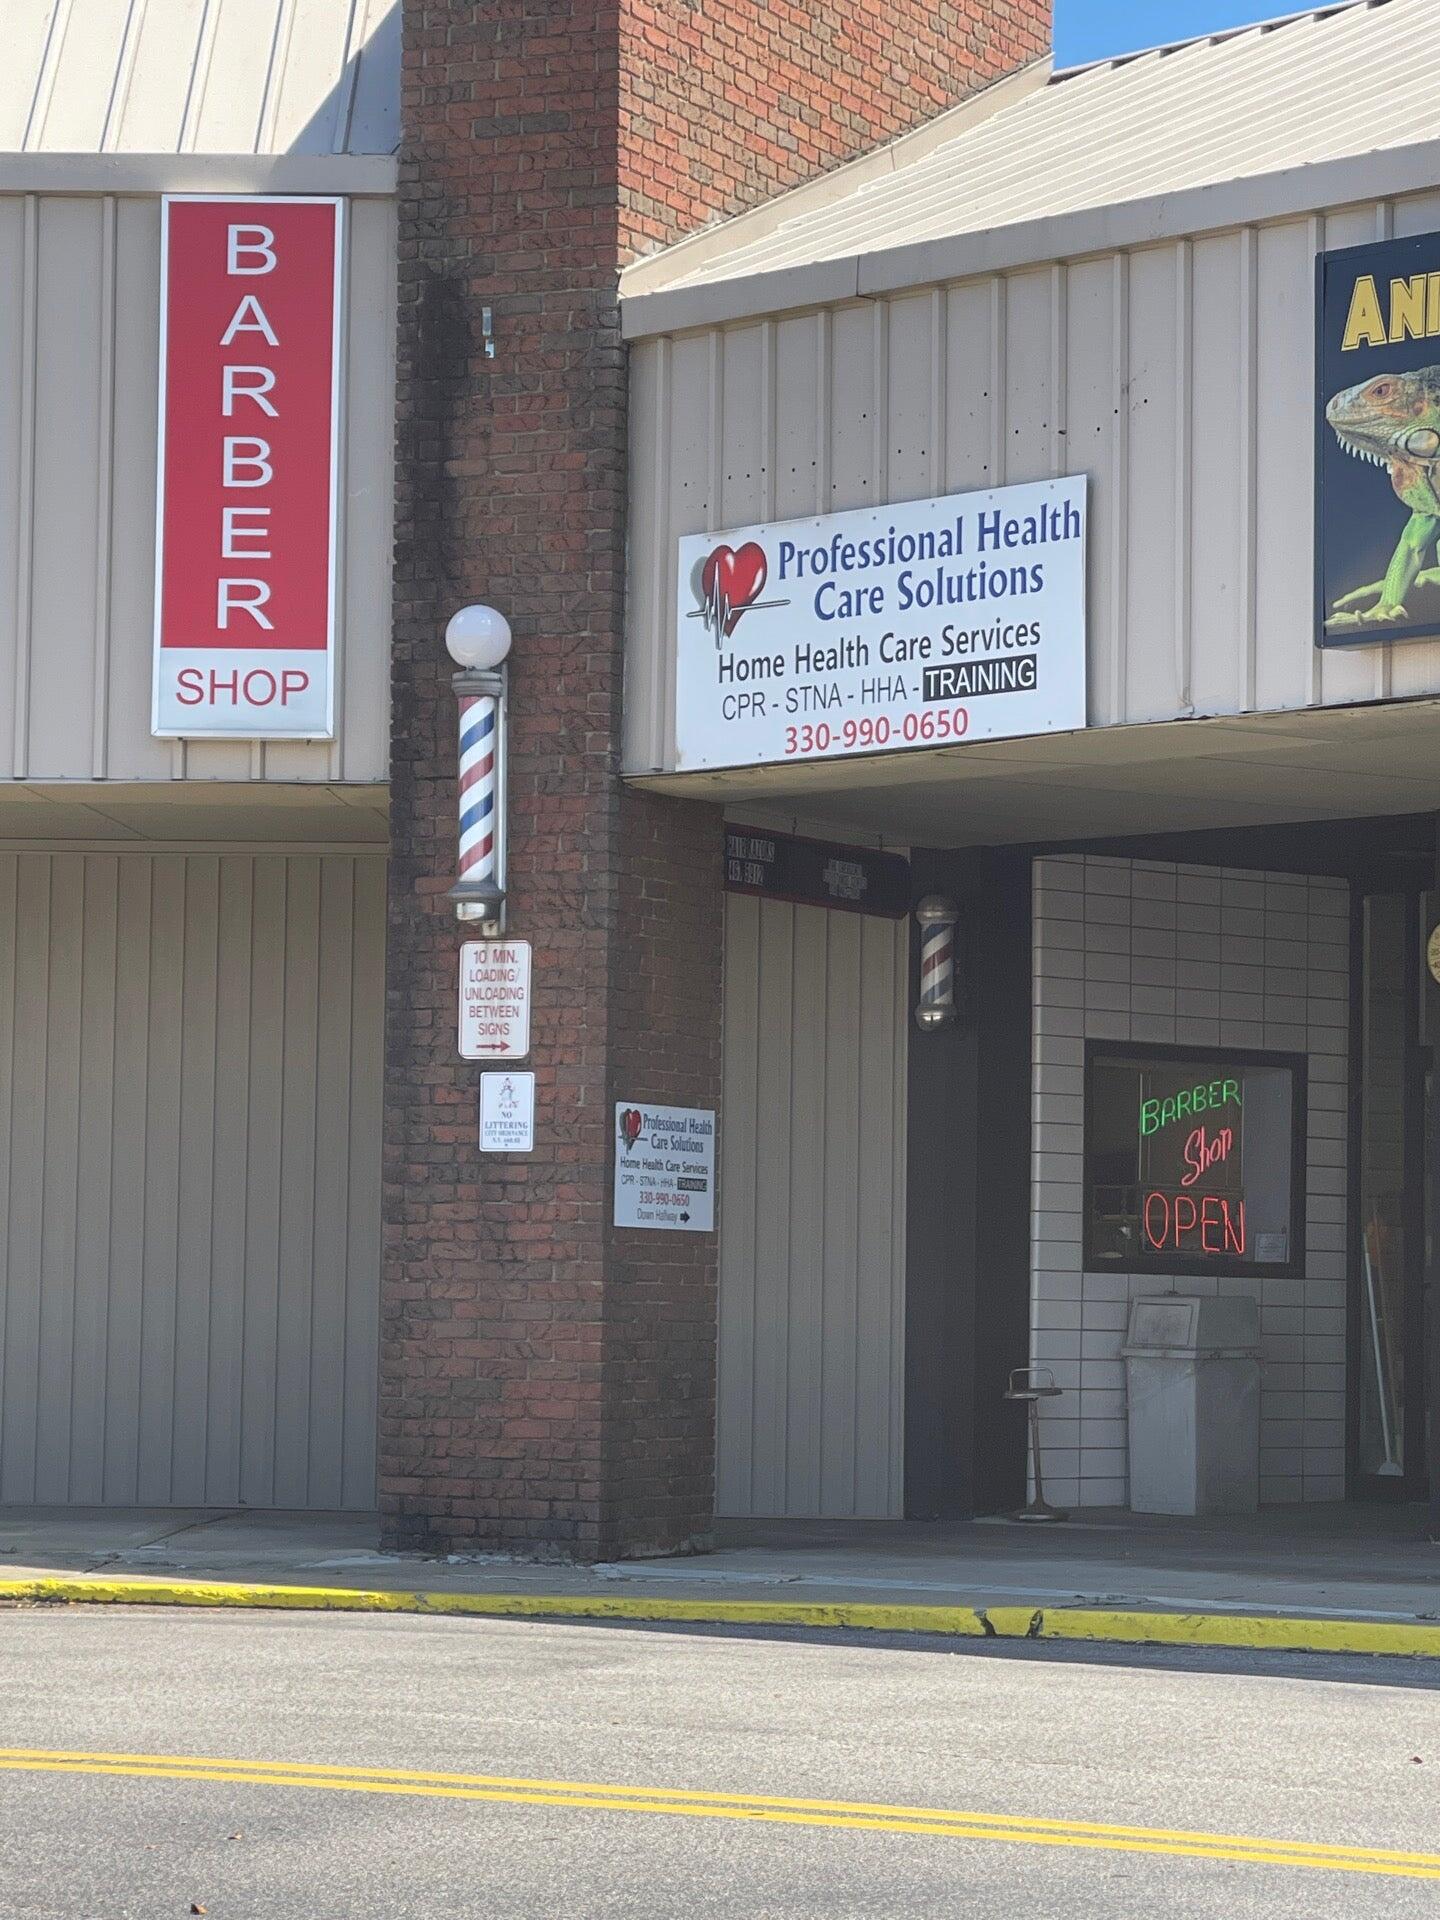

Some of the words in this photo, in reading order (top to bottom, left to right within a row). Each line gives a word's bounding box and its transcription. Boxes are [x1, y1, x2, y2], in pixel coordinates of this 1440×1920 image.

[1341, 271, 1440, 352] ANI
[216, 224, 280, 630] BARBER
[778, 515, 963, 580] Professional
[978, 499, 1081, 552] Health
[814, 581, 884, 621] Care
[898, 561, 1044, 610] Solutions
[718, 652, 785, 684] Home
[795, 635, 869, 674] Health
[879, 632, 932, 664] Care
[941, 617, 1041, 657] Services
[175, 668, 309, 706] SHOP
[722, 691, 766, 721] CPR
[785, 682, 842, 714] STNA
[861, 674, 907, 705] HHA
[925, 658, 1035, 699] TRAINING
[785, 707, 969, 754] 330-990-0650
[473, 949, 487, 964] 10
[492, 948, 518, 964] MIN.
[464, 986, 524, 1001] UNLOADING
[469, 1005, 520, 1018] BETWEEN
[478, 1022, 510, 1036] SIGNS
[501, 1111, 512, 1119] NO
[1141, 1078, 1242, 1136] BARBER
[485, 1121, 528, 1129] LITTERING
[643, 1113, 687, 1133] Professional
[689, 1118, 713, 1136] Health
[651, 1133, 668, 1150] Care
[670, 1136, 704, 1153] Solutions
[620, 1156, 640, 1169] Home
[642, 1158, 664, 1171] Health
[665, 1160, 680, 1172] Care
[682, 1161, 708, 1175] Services
[621, 1174, 635, 1185] CPR
[639, 1190, 690, 1207] 330-990-0650
[637, 1207, 655, 1220] Down
[1144, 1191, 1246, 1256] OPEN
